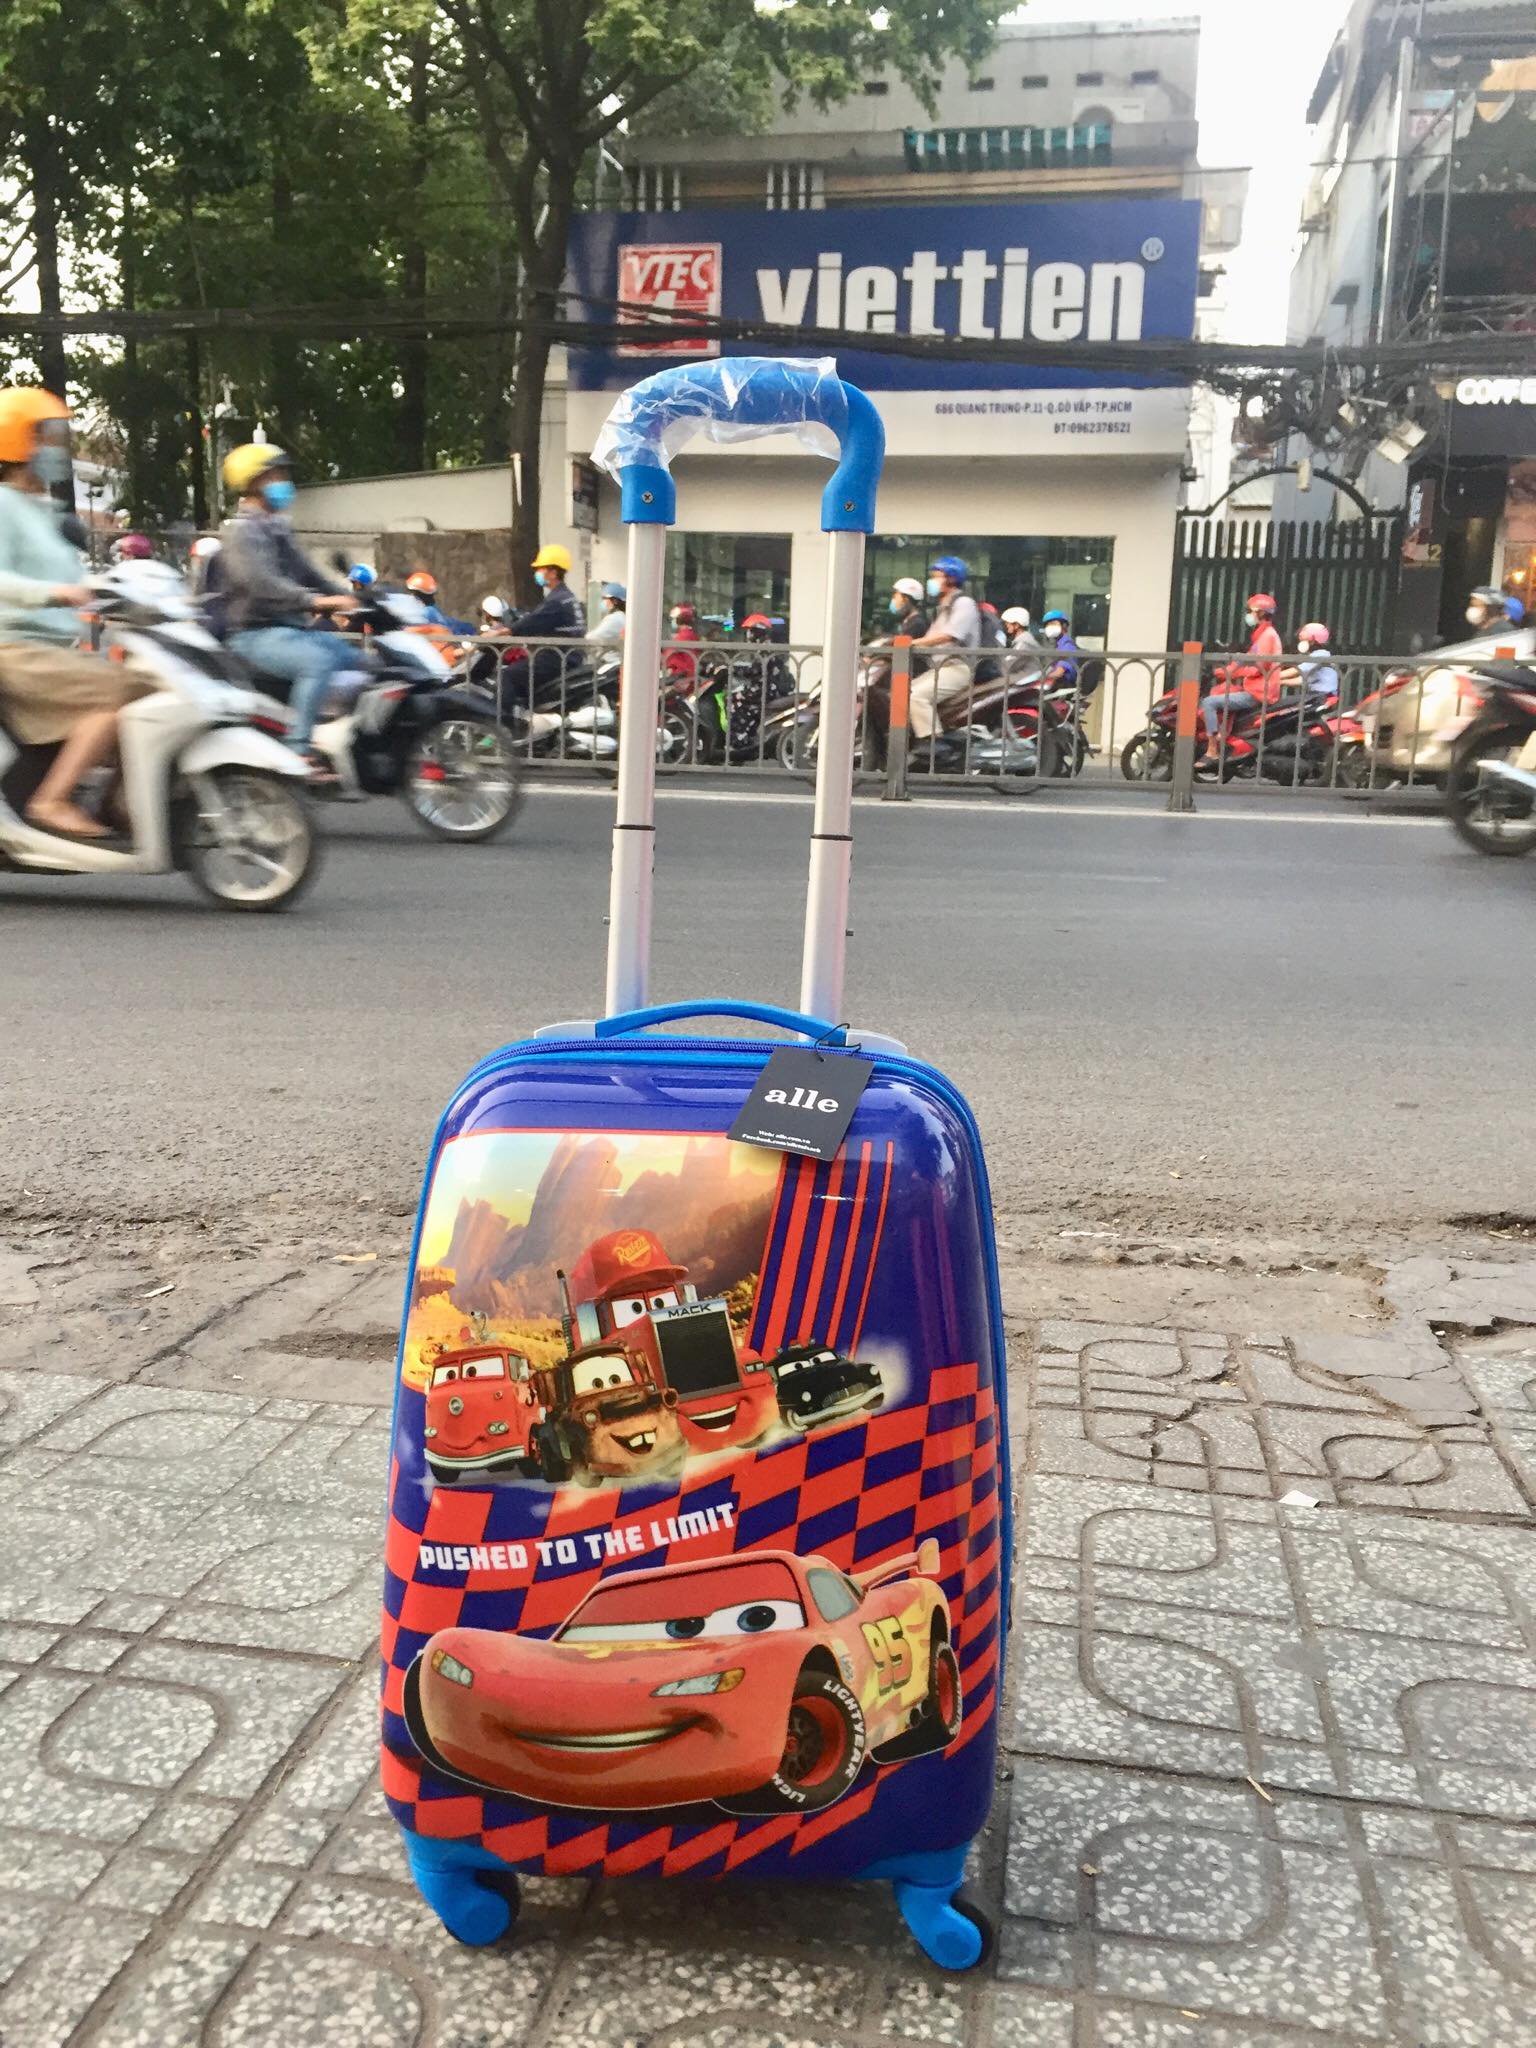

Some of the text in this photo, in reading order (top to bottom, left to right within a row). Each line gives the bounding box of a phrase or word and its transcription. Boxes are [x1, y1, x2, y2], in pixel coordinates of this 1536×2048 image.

[626, 253, 712, 294] VTEC
[756, 248, 1145, 341] viettien
[955, 403, 987, 415] QUANG
[764, 1087, 839, 1113] alle
[668, 1303, 711, 1318] MACK
[419, 1502, 735, 1570] PUSHED TO THE LIMIT
[860, 1615, 913, 1696] 95
[823, 1679, 865, 1778] LIGHTYEAR
